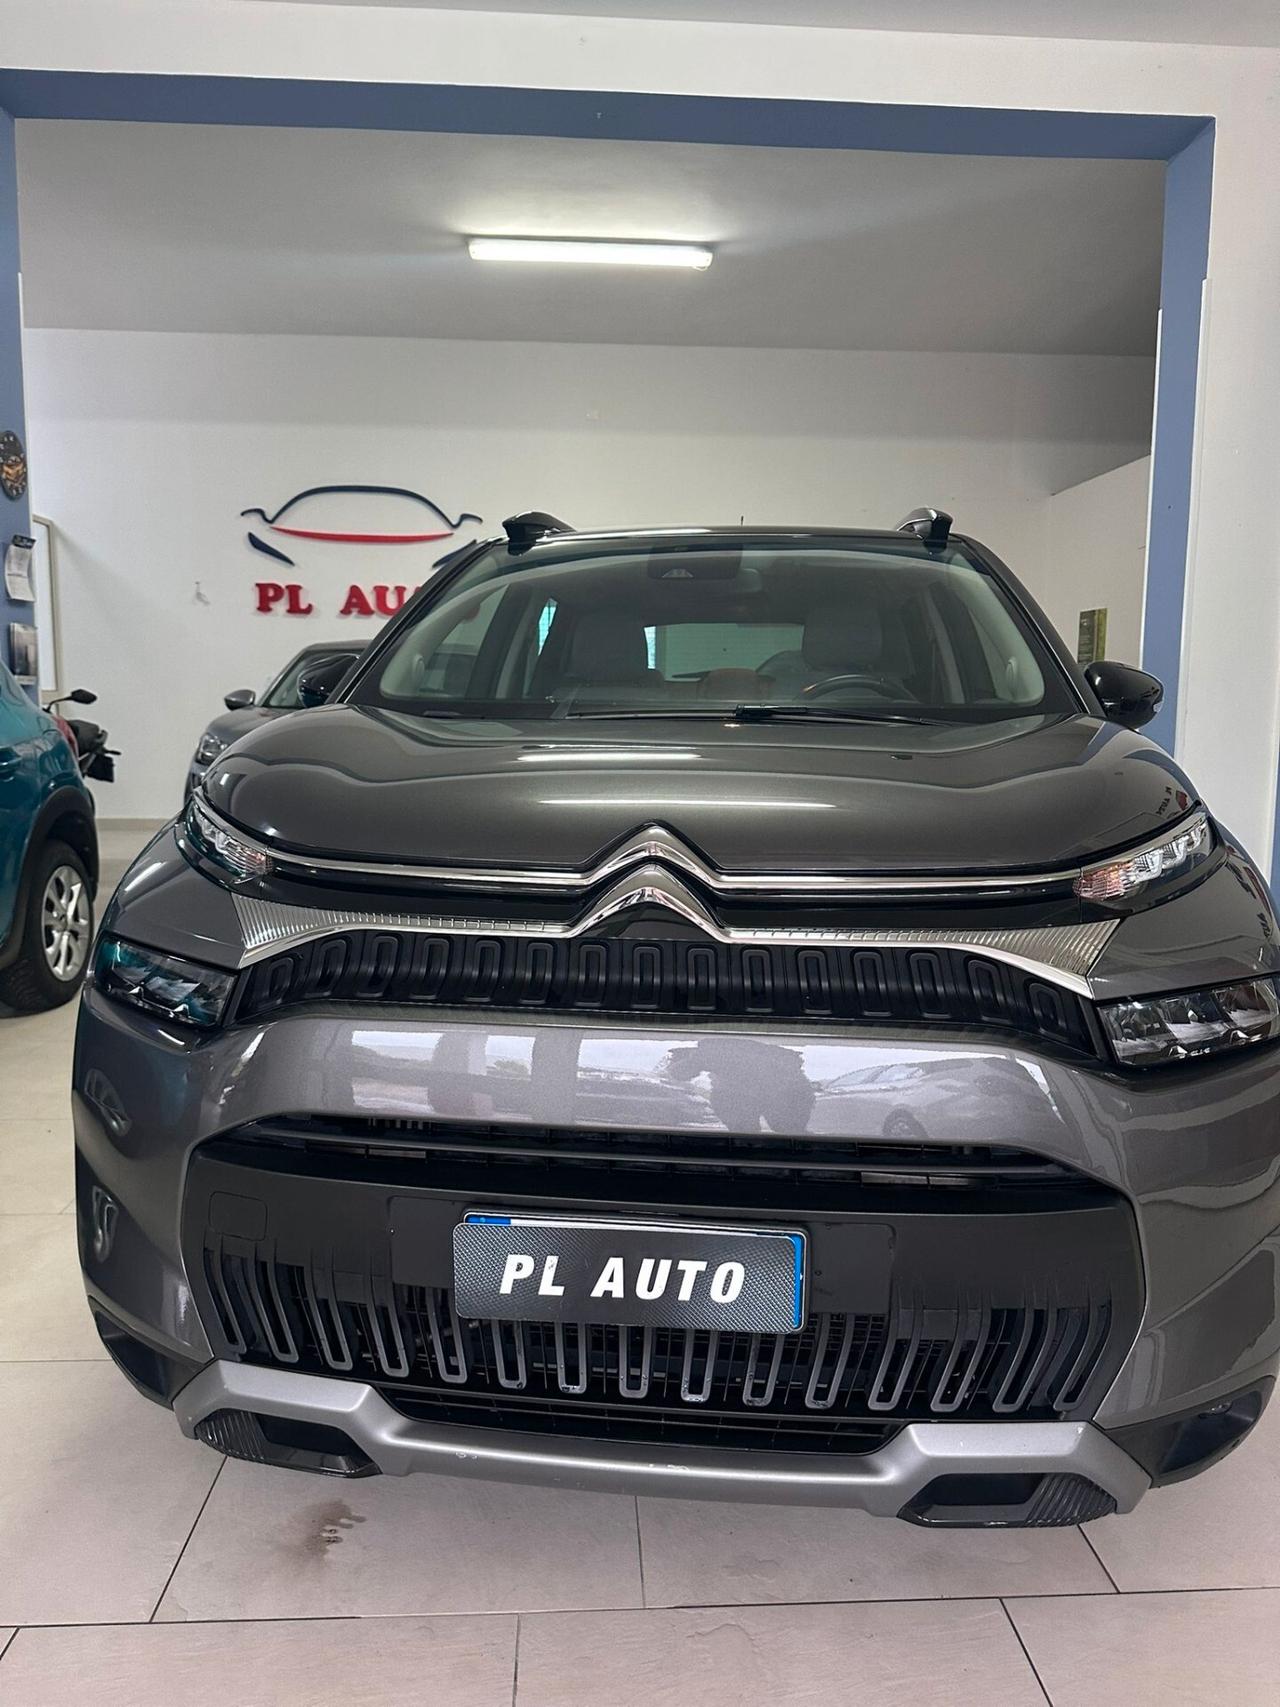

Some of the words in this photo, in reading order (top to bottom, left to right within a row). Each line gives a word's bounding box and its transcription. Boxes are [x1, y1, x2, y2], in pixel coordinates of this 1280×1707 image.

[255, 582, 313, 615] PL
[340, 585, 422, 616] AU
[499, 1253, 566, 1297] PL
[590, 1257, 746, 1304] AUTO
